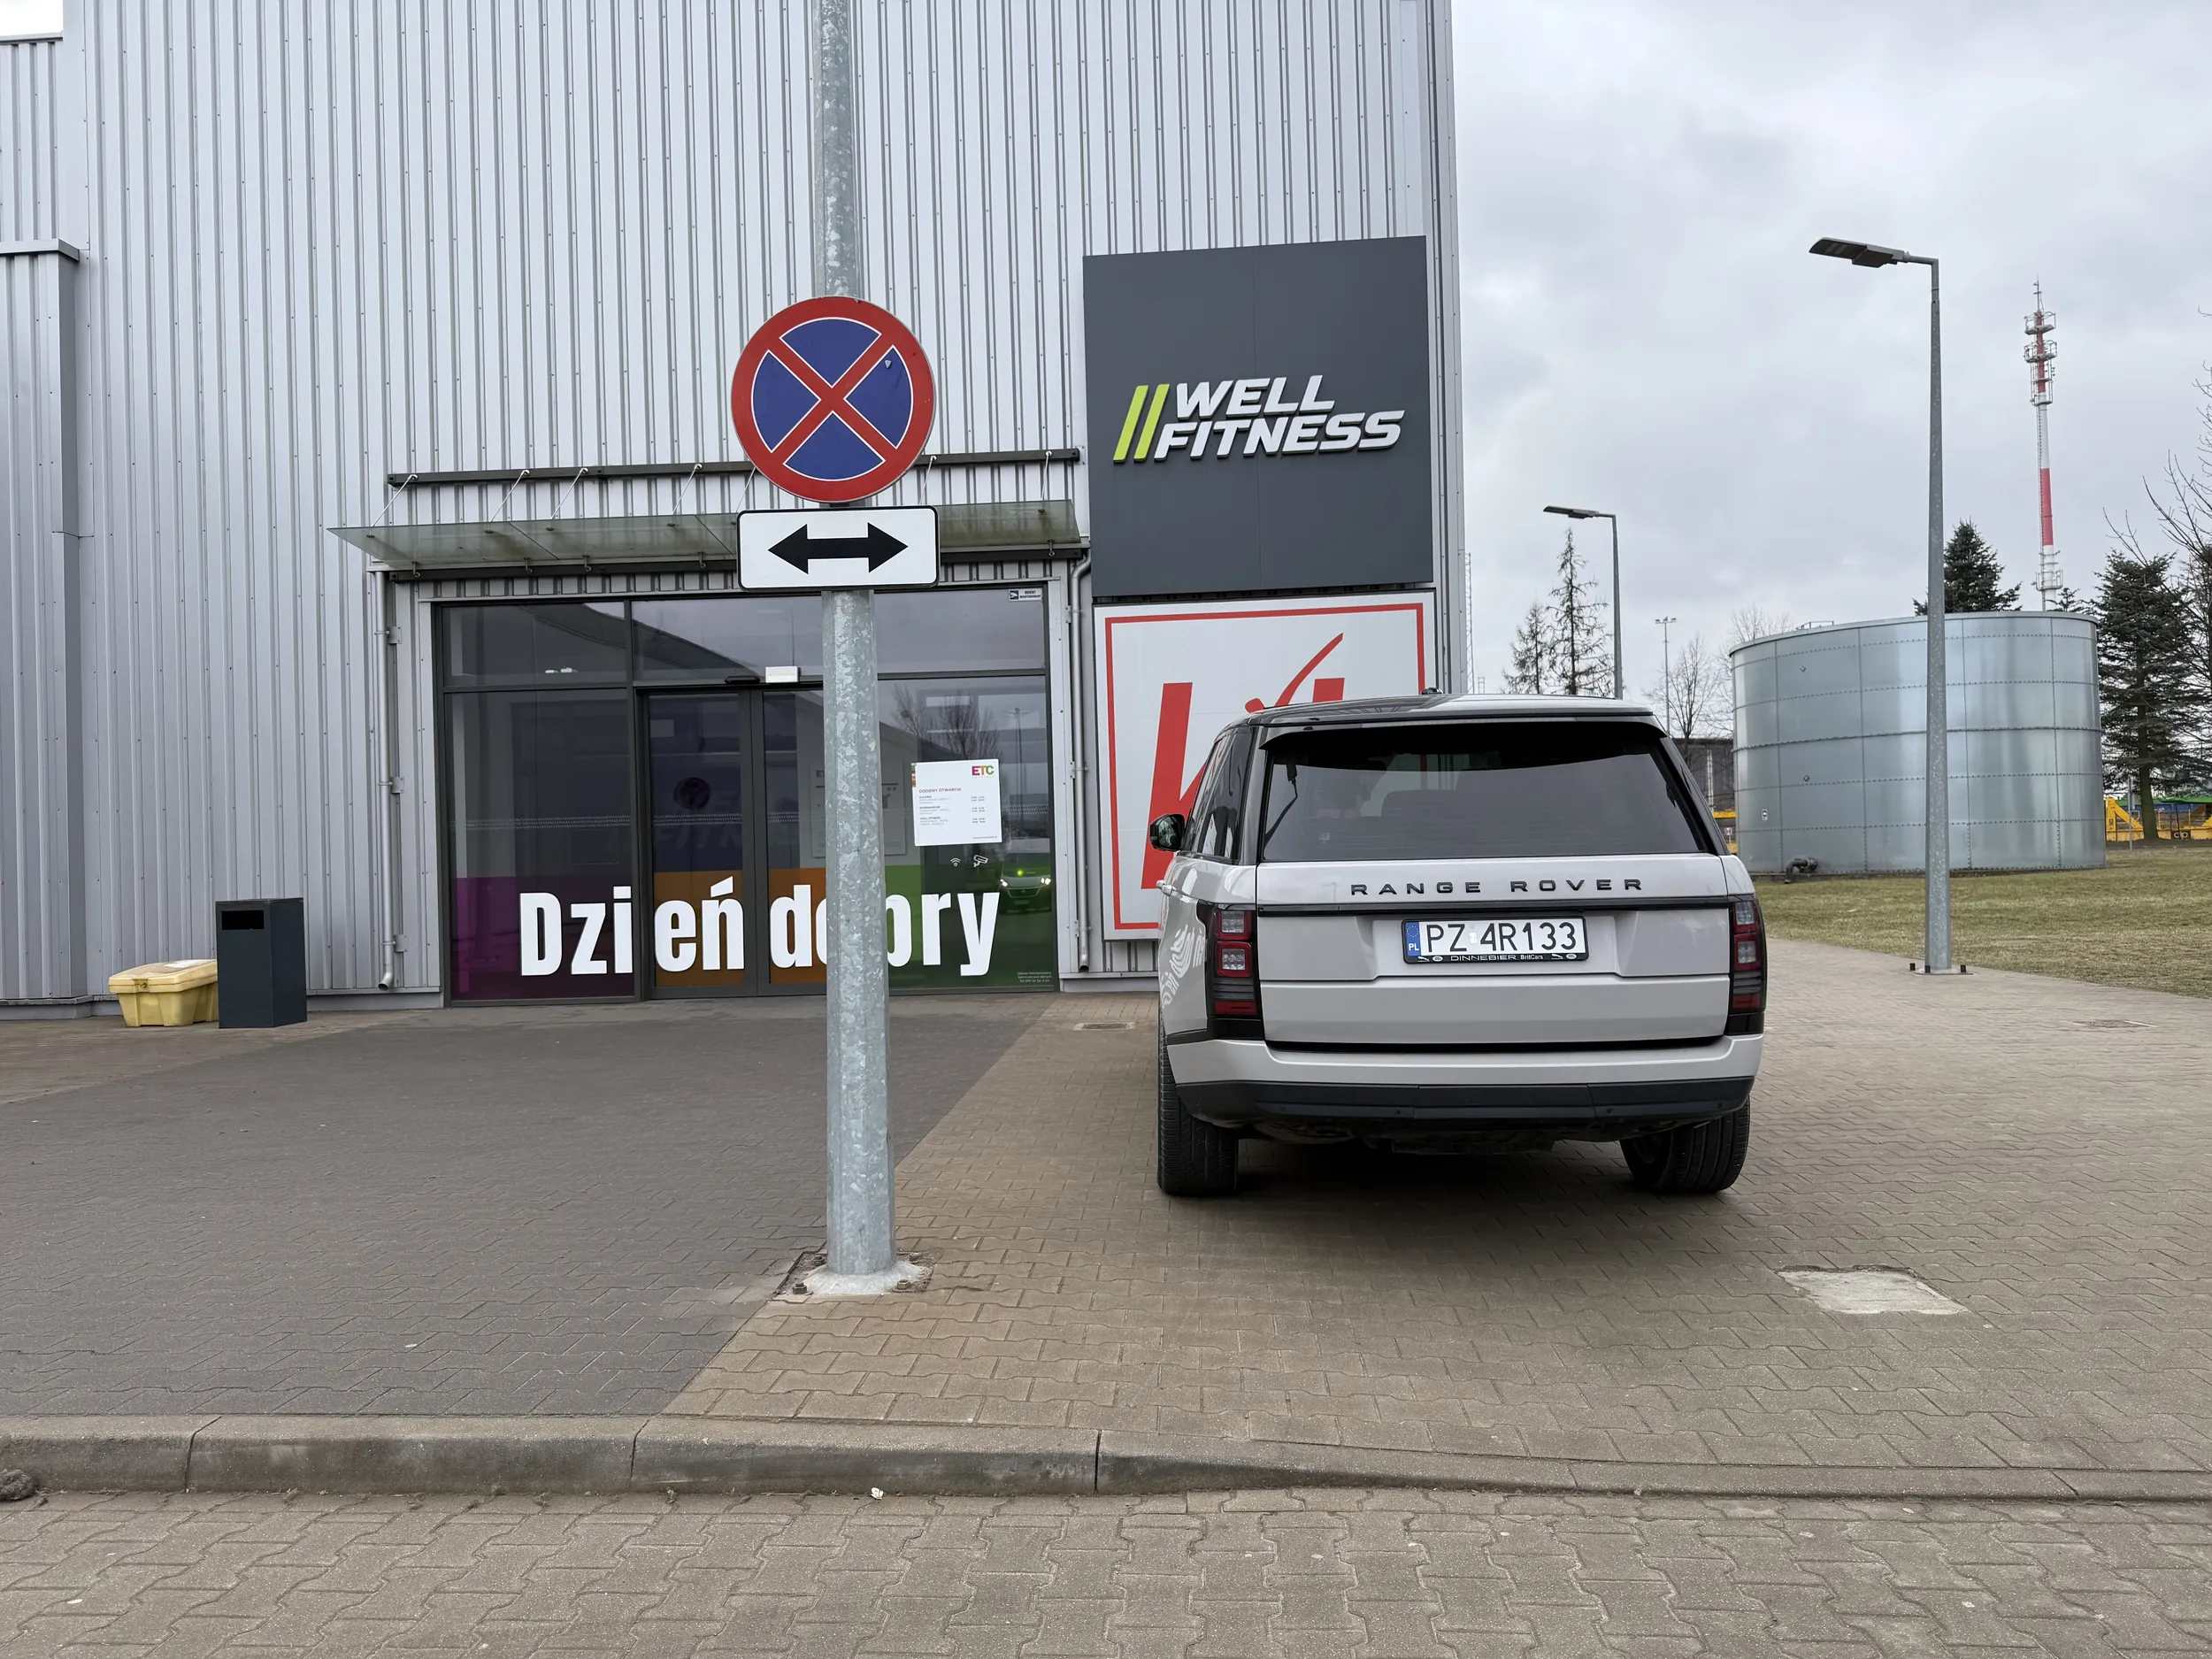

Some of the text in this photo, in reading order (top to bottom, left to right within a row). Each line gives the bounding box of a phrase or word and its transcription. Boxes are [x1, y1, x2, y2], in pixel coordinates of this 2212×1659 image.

[1176, 375, 1335, 419] WELL
[1154, 410, 1405, 460] FITNESS
[972, 765, 995, 776] ETC
[1350, 879, 1642, 895] RANGE ROVER
[1426, 922, 1577, 953] PZ 4R133
